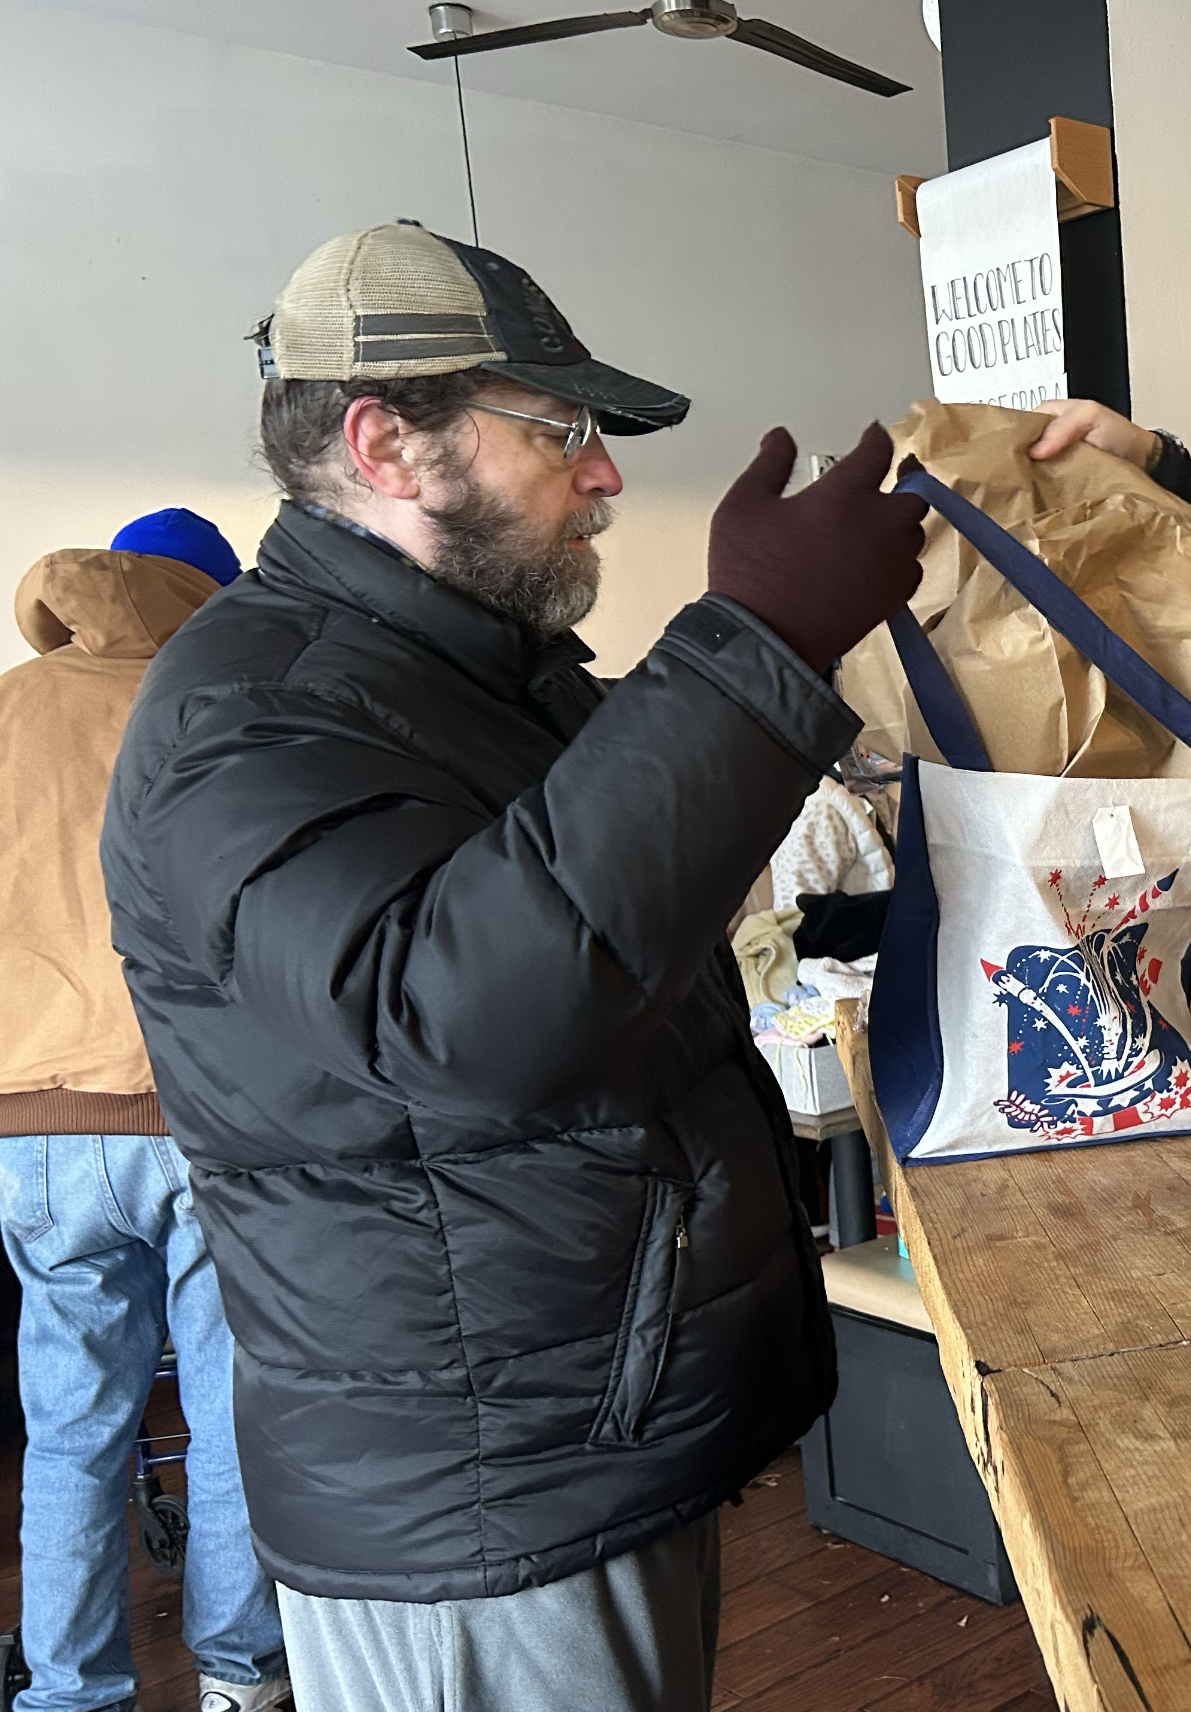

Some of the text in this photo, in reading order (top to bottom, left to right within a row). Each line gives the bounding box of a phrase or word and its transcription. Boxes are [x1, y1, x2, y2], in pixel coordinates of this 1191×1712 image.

[930, 252, 1053, 326] WELCOME TO
[935, 308, 1063, 377] GOOD PLATES
